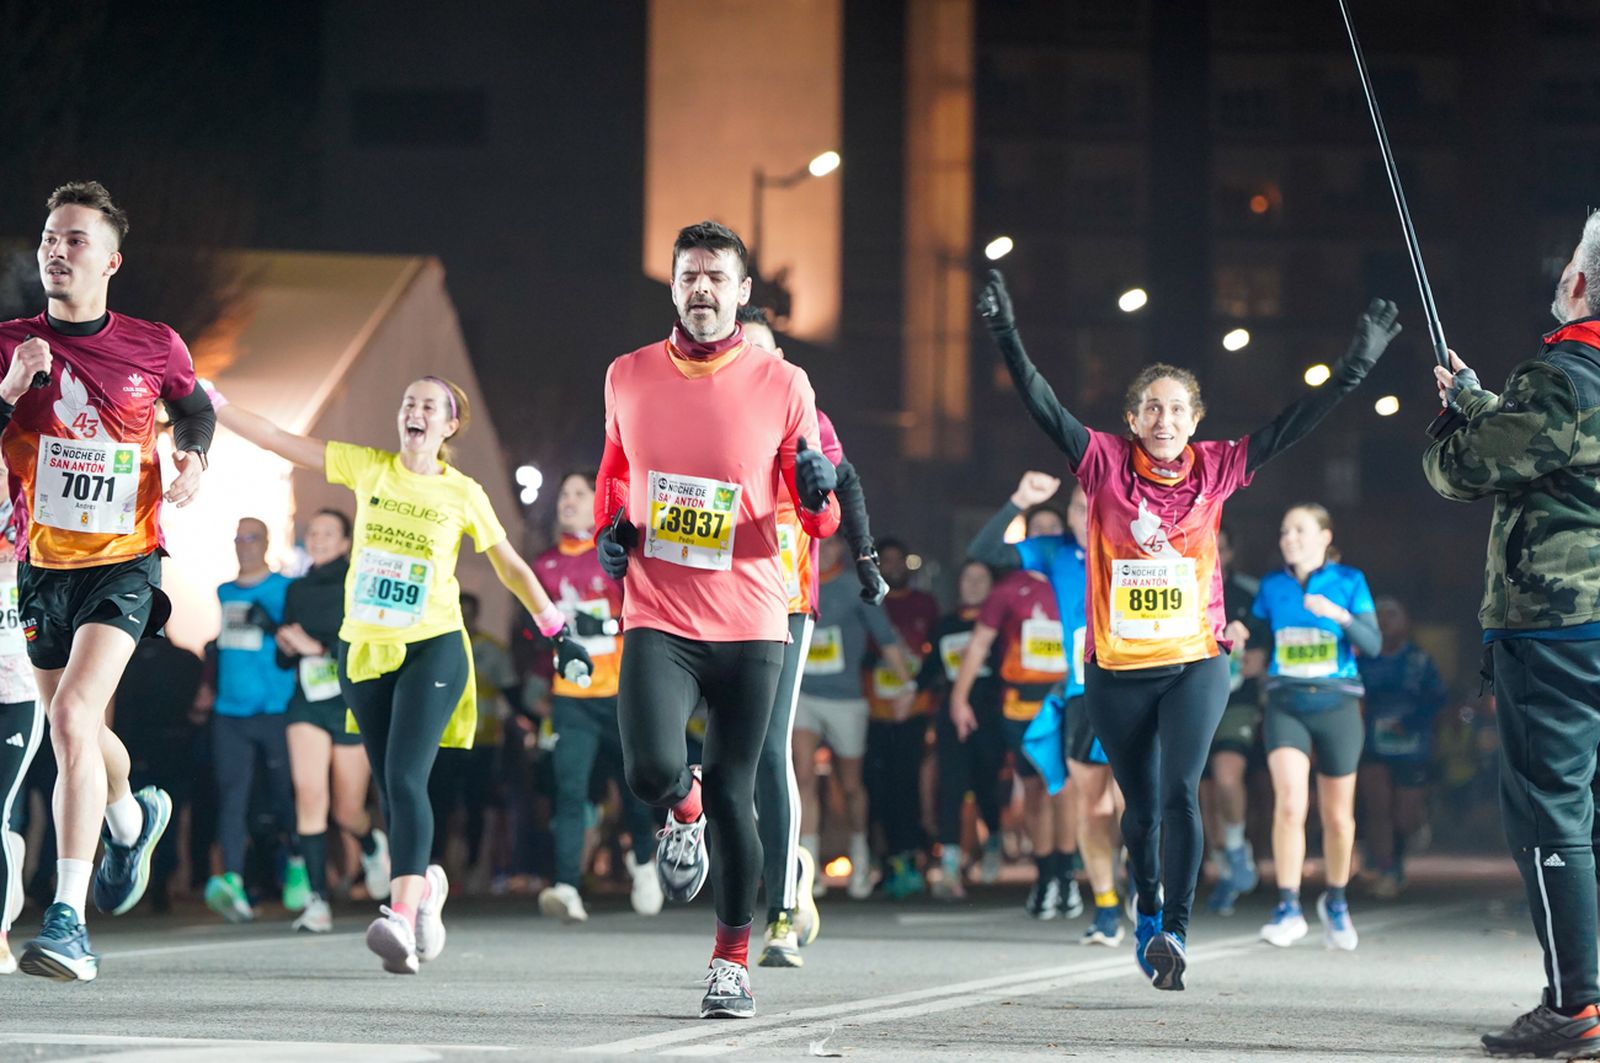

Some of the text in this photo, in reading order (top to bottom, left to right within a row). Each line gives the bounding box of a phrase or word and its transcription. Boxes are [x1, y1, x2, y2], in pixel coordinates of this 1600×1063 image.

[71, 412, 99, 439] 43
[62, 449, 93, 461] NOCHE
[94, 453, 106, 462] DE
[49, 458, 70, 470] SAN
[71, 460, 105, 473] ANTÓN
[61, 472, 116, 502] 7071
[667, 484, 694, 497] NOCHE
[695, 488, 708, 498] DE
[659, 504, 725, 539] 13937
[1131, 568, 1156, 577] NOCHE
[1157, 568, 1168, 577] DE
[1121, 578, 1138, 587] SAN
[1129, 588, 1183, 611] 8919
